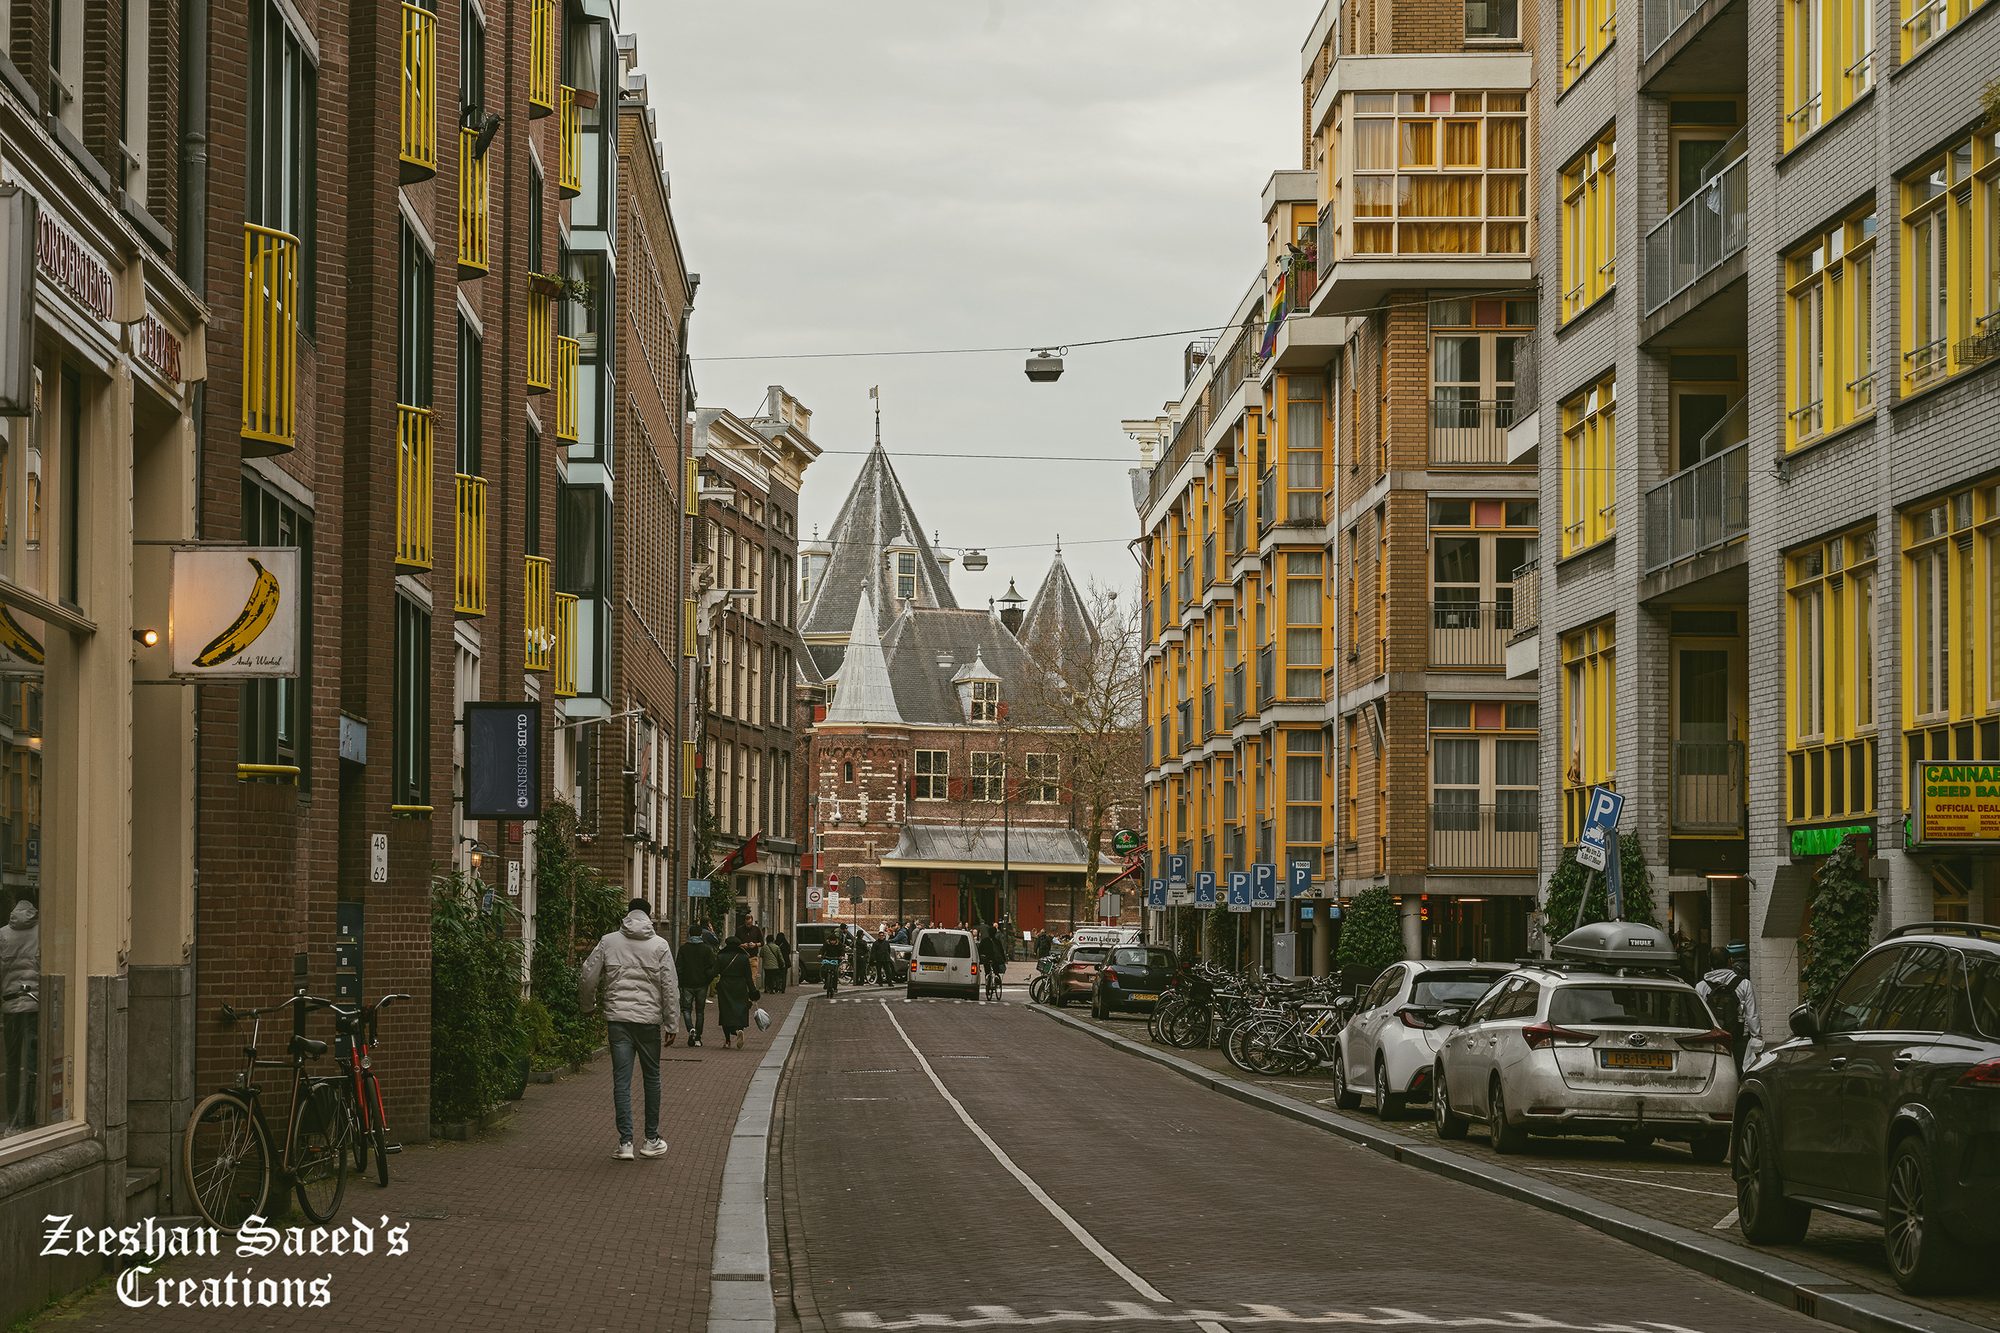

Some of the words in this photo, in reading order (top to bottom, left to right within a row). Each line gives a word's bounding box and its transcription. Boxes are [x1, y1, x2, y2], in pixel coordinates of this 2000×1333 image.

[232, 656, 253, 667] Andy
[256, 656, 282, 666] Warhol
[517, 714, 528, 796] CLUBCUISINE
[1927, 786, 1971, 797] SEED
[1976, 786, 2000, 797] BA
[1593, 793, 1614, 822] P
[1936, 804, 1975, 813] OFFICIAL
[374, 836, 385, 850] 48
[510, 862, 519, 873] 34
[1172, 857, 1183, 873] P
[373, 866, 385, 881] 62
[1257, 866, 1271, 885] P
[1296, 870, 1306, 885] P
[509, 884, 518, 894] 44
[1152, 881, 1163, 894] P
[1199, 874, 1212, 890] P
[1233, 874, 1246, 891] P
